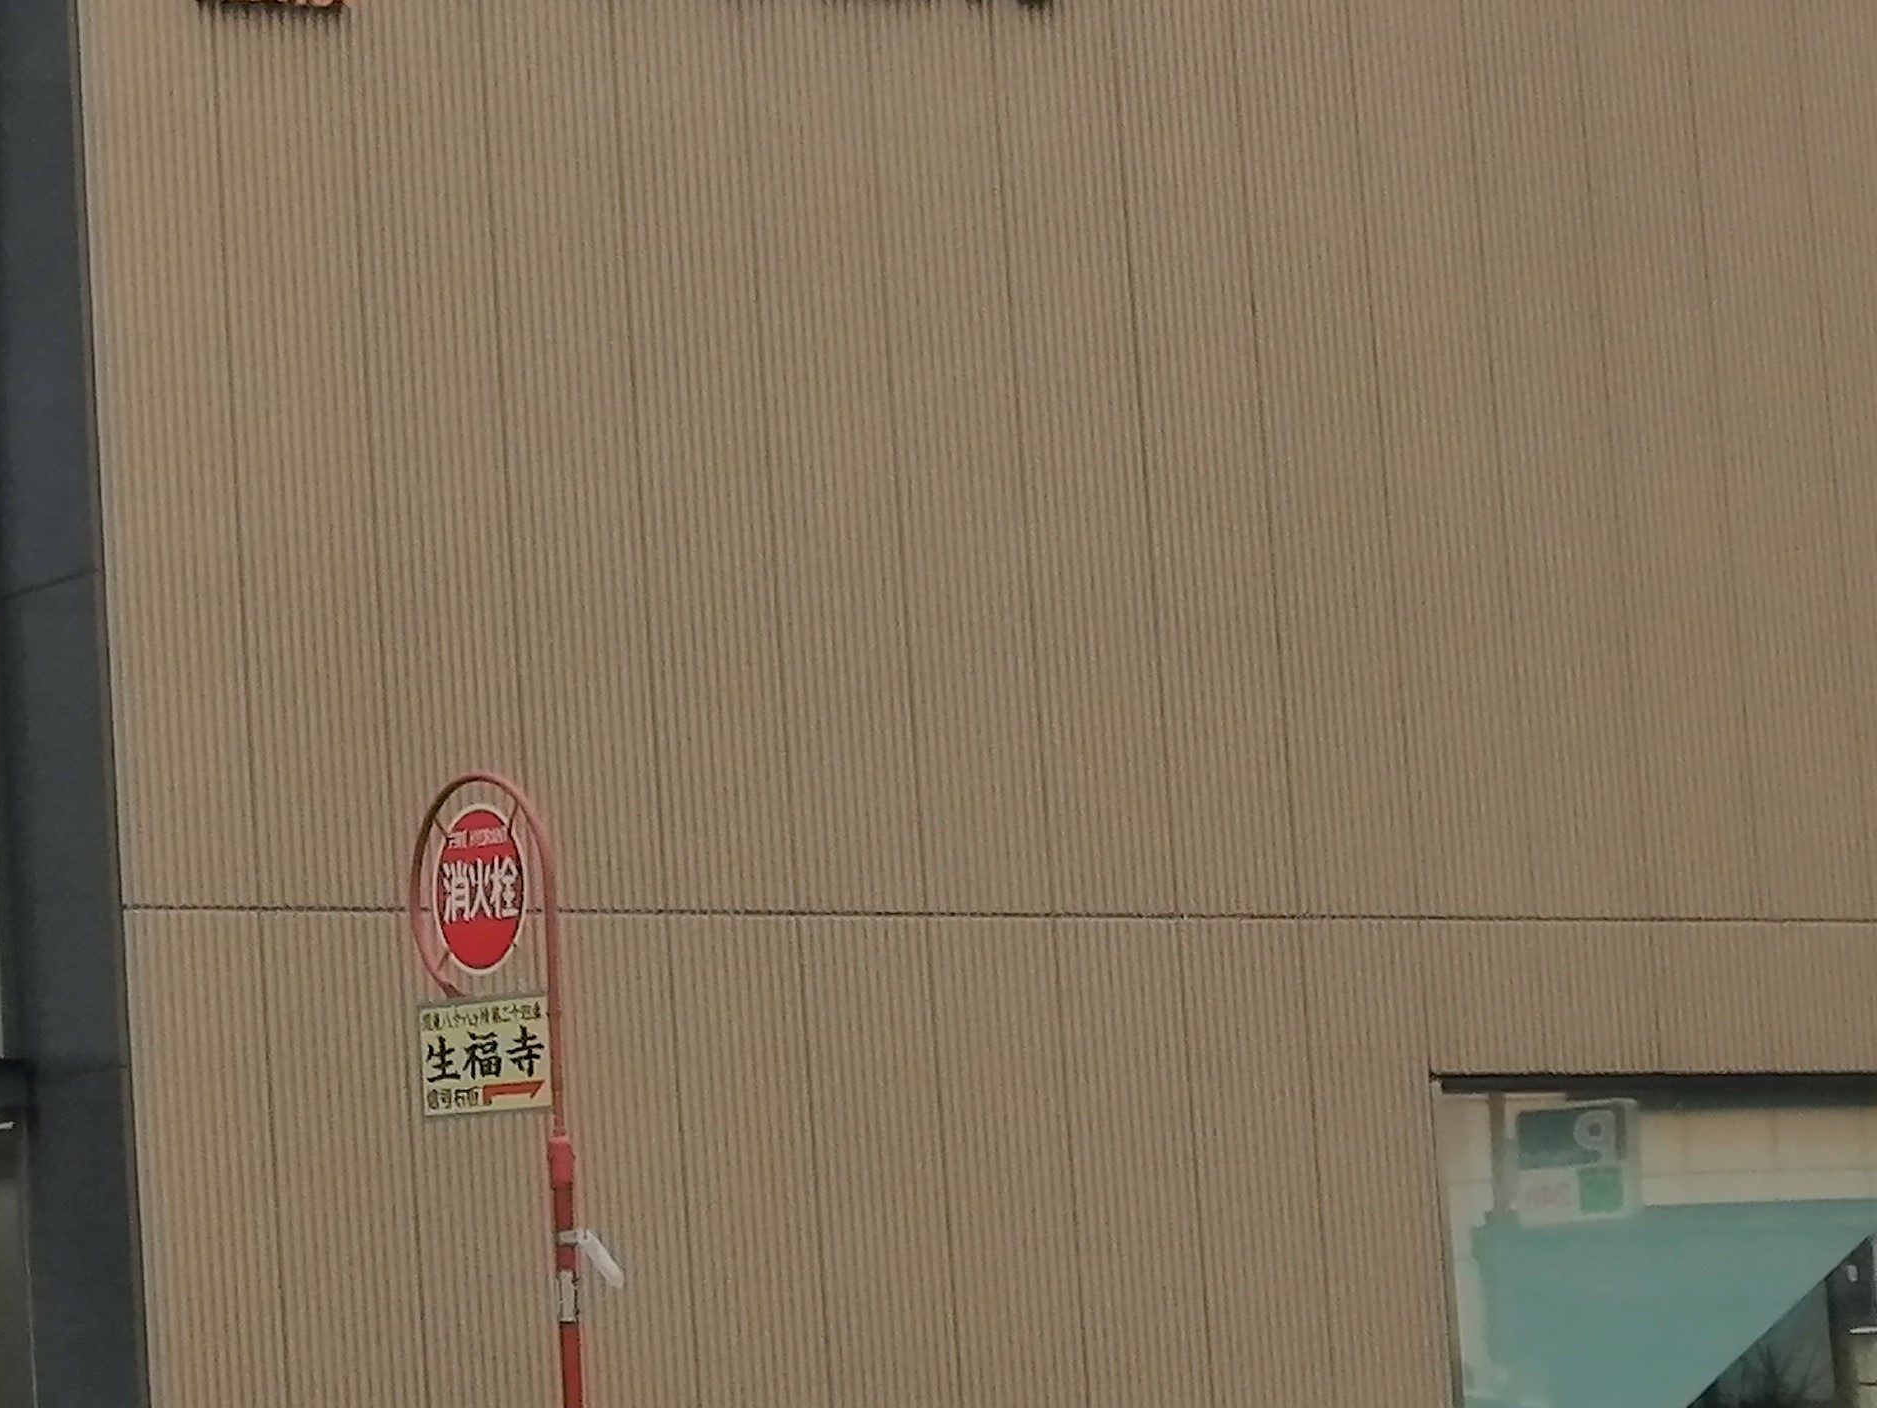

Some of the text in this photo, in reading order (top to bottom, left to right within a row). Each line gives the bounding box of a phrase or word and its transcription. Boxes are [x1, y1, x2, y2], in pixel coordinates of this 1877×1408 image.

[442, 855, 521, 925] 消火栓
[425, 1024, 545, 1084] 生福寺
